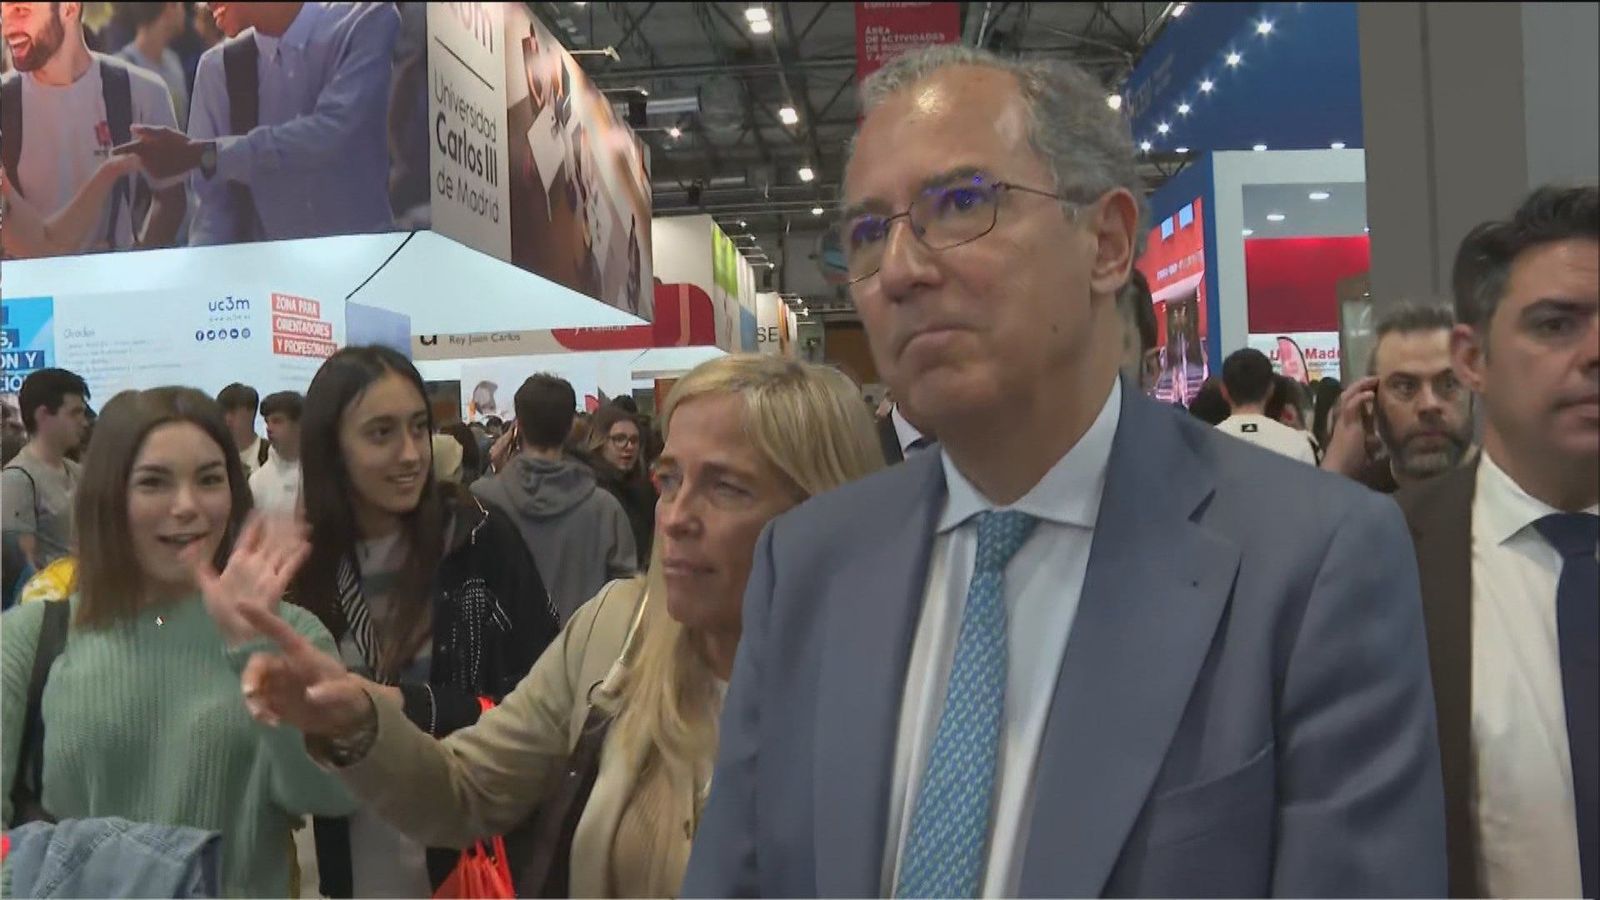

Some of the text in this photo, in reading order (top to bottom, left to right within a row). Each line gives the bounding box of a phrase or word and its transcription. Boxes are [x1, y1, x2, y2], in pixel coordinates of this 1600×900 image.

[434, 70, 496, 143] Universidad
[436, 111, 498, 188] Carlos III
[437, 167, 499, 223] de Madrid
[208, 296, 250, 312] uc3m
[275, 295, 318, 316] ZONA PARA
[277, 318, 331, 337] ORIENTADORES
[277, 338, 284, 351] Y
[449, 335, 466, 345] Rey
[468, 334, 488, 345] Juan
[491, 332, 521, 343] Carlos
[25, 351, 37, 368] Y
